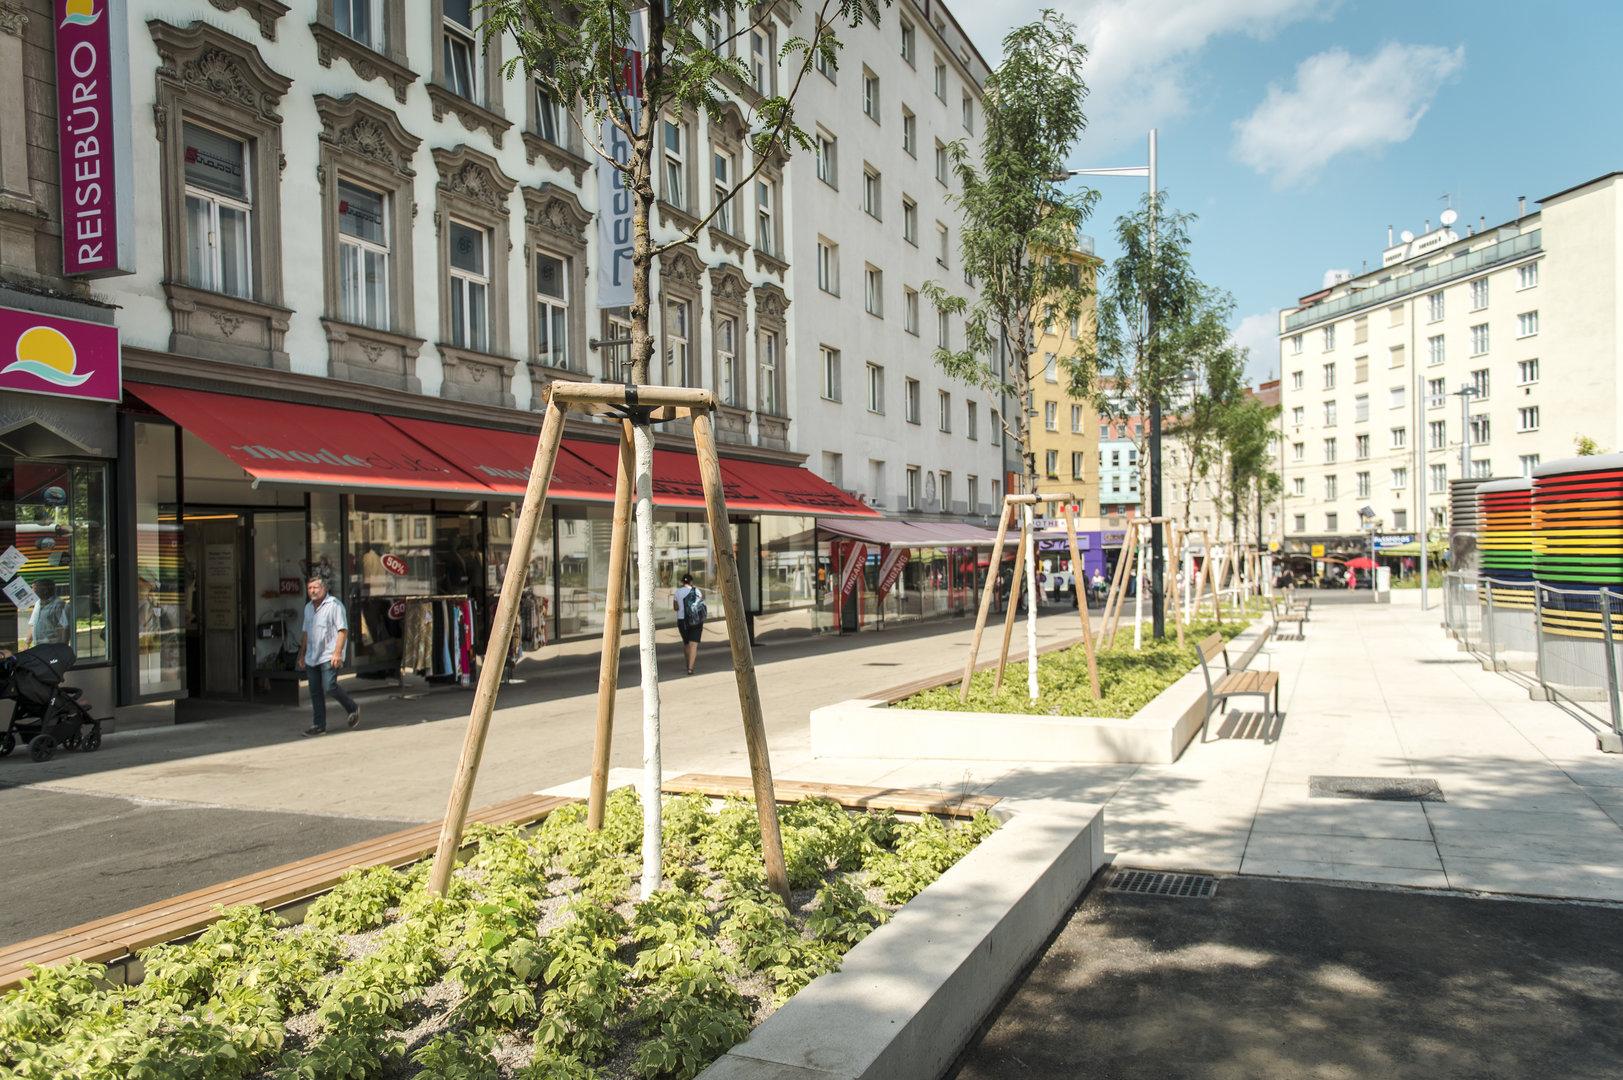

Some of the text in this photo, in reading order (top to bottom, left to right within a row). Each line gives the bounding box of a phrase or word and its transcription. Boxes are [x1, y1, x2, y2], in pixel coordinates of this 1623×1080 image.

[67, 41, 103, 264] REISEBÜRO
[386, 556, 406, 575] 50%
[843, 556, 866, 595] EINGANG
[881, 555, 908, 592] EINGANG
[280, 581, 299, 592] 50%
[394, 602, 406, 615] 50
